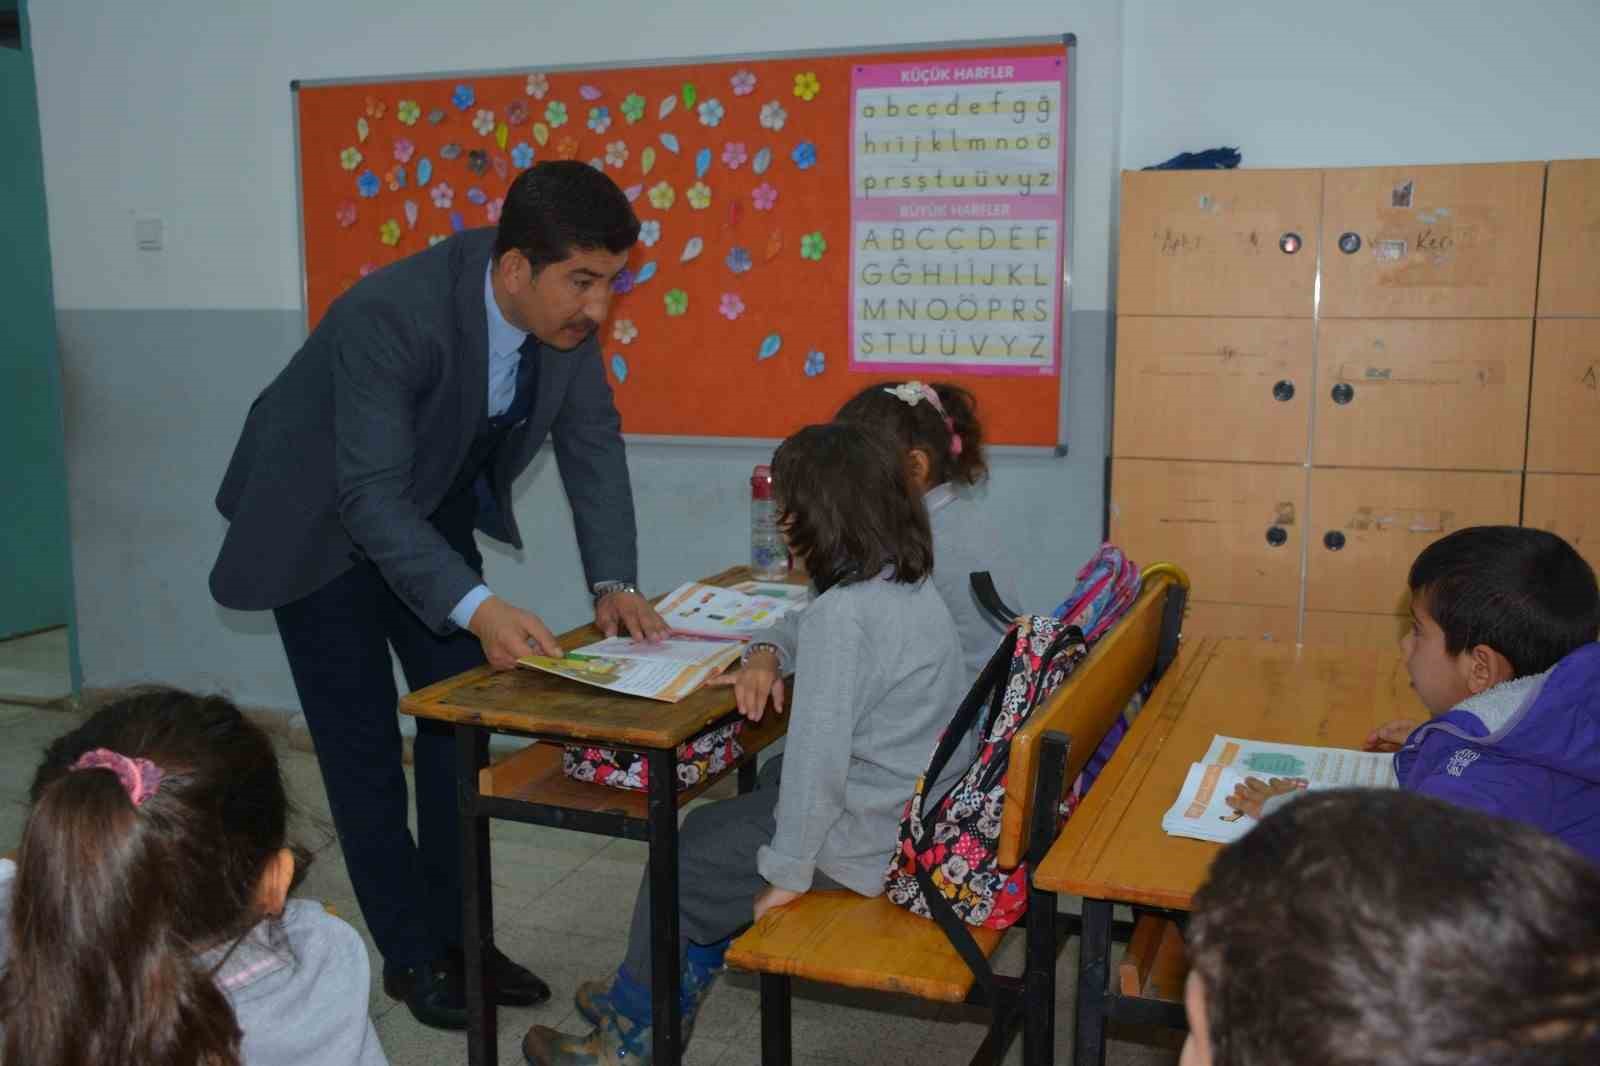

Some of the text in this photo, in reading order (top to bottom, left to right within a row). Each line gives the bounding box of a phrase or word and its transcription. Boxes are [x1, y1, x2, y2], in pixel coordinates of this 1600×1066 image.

[901, 66, 1014, 84] KÜÇÜK HARFLER
[864, 90, 1049, 123] a b c ç d e f g ğ
[865, 132, 876, 152] h
[899, 137, 903, 152] i
[912, 136, 919, 162] j
[932, 129, 942, 151] k
[952, 128, 958, 151] l
[969, 138, 986, 150] m
[996, 137, 1008, 149] n
[1016, 136, 1028, 149] o
[1038, 134, 1050, 149] ö
[864, 170, 1050, 199] p r s ş t u ü v y z
[864, 227, 1049, 253] A B C Ç D E F
[863, 264, 881, 285] G
[891, 259, 912, 285] Ğ
[923, 264, 940, 285] H
[968, 258, 974, 284] İ
[982, 264, 994, 285] J
[1008, 264, 1022, 285] K
[1034, 264, 1048, 285] L
[864, 293, 1047, 321] M N O Ö P R S
[883, 333, 896, 353] T
[909, 334, 926, 354] U
[939, 329, 956, 355] Ü
[970, 335, 988, 355] V
[1002, 336, 1016, 355] Y
[1031, 336, 1045, 358] Z
